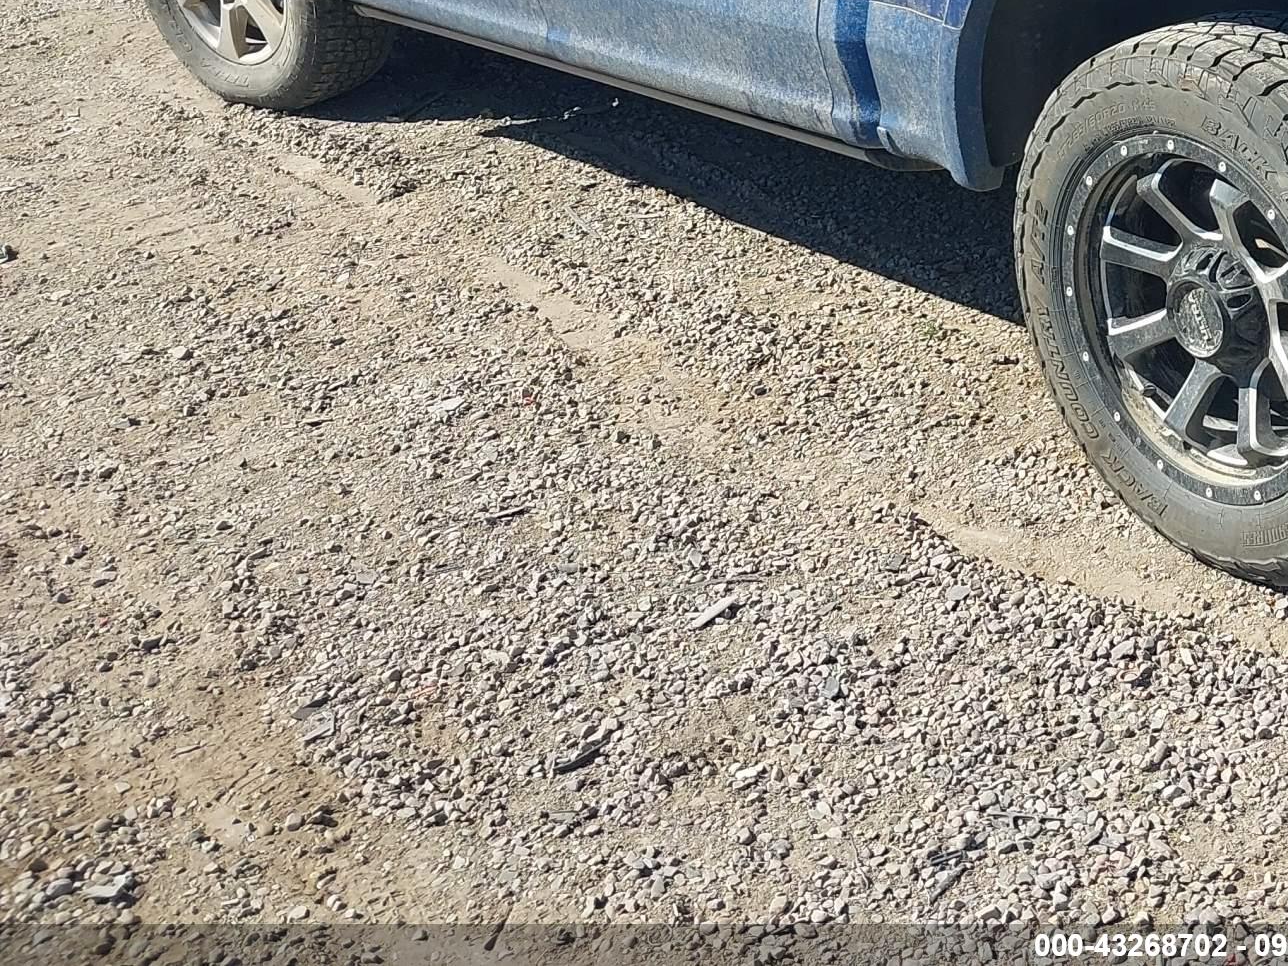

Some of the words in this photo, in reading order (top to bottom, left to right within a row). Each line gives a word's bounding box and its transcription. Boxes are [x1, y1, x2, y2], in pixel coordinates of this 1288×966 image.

[1201, 114, 1278, 181] BACK
[1034, 296, 1100, 440] COUNTRY
[1100, 448, 1169, 517] BACK
